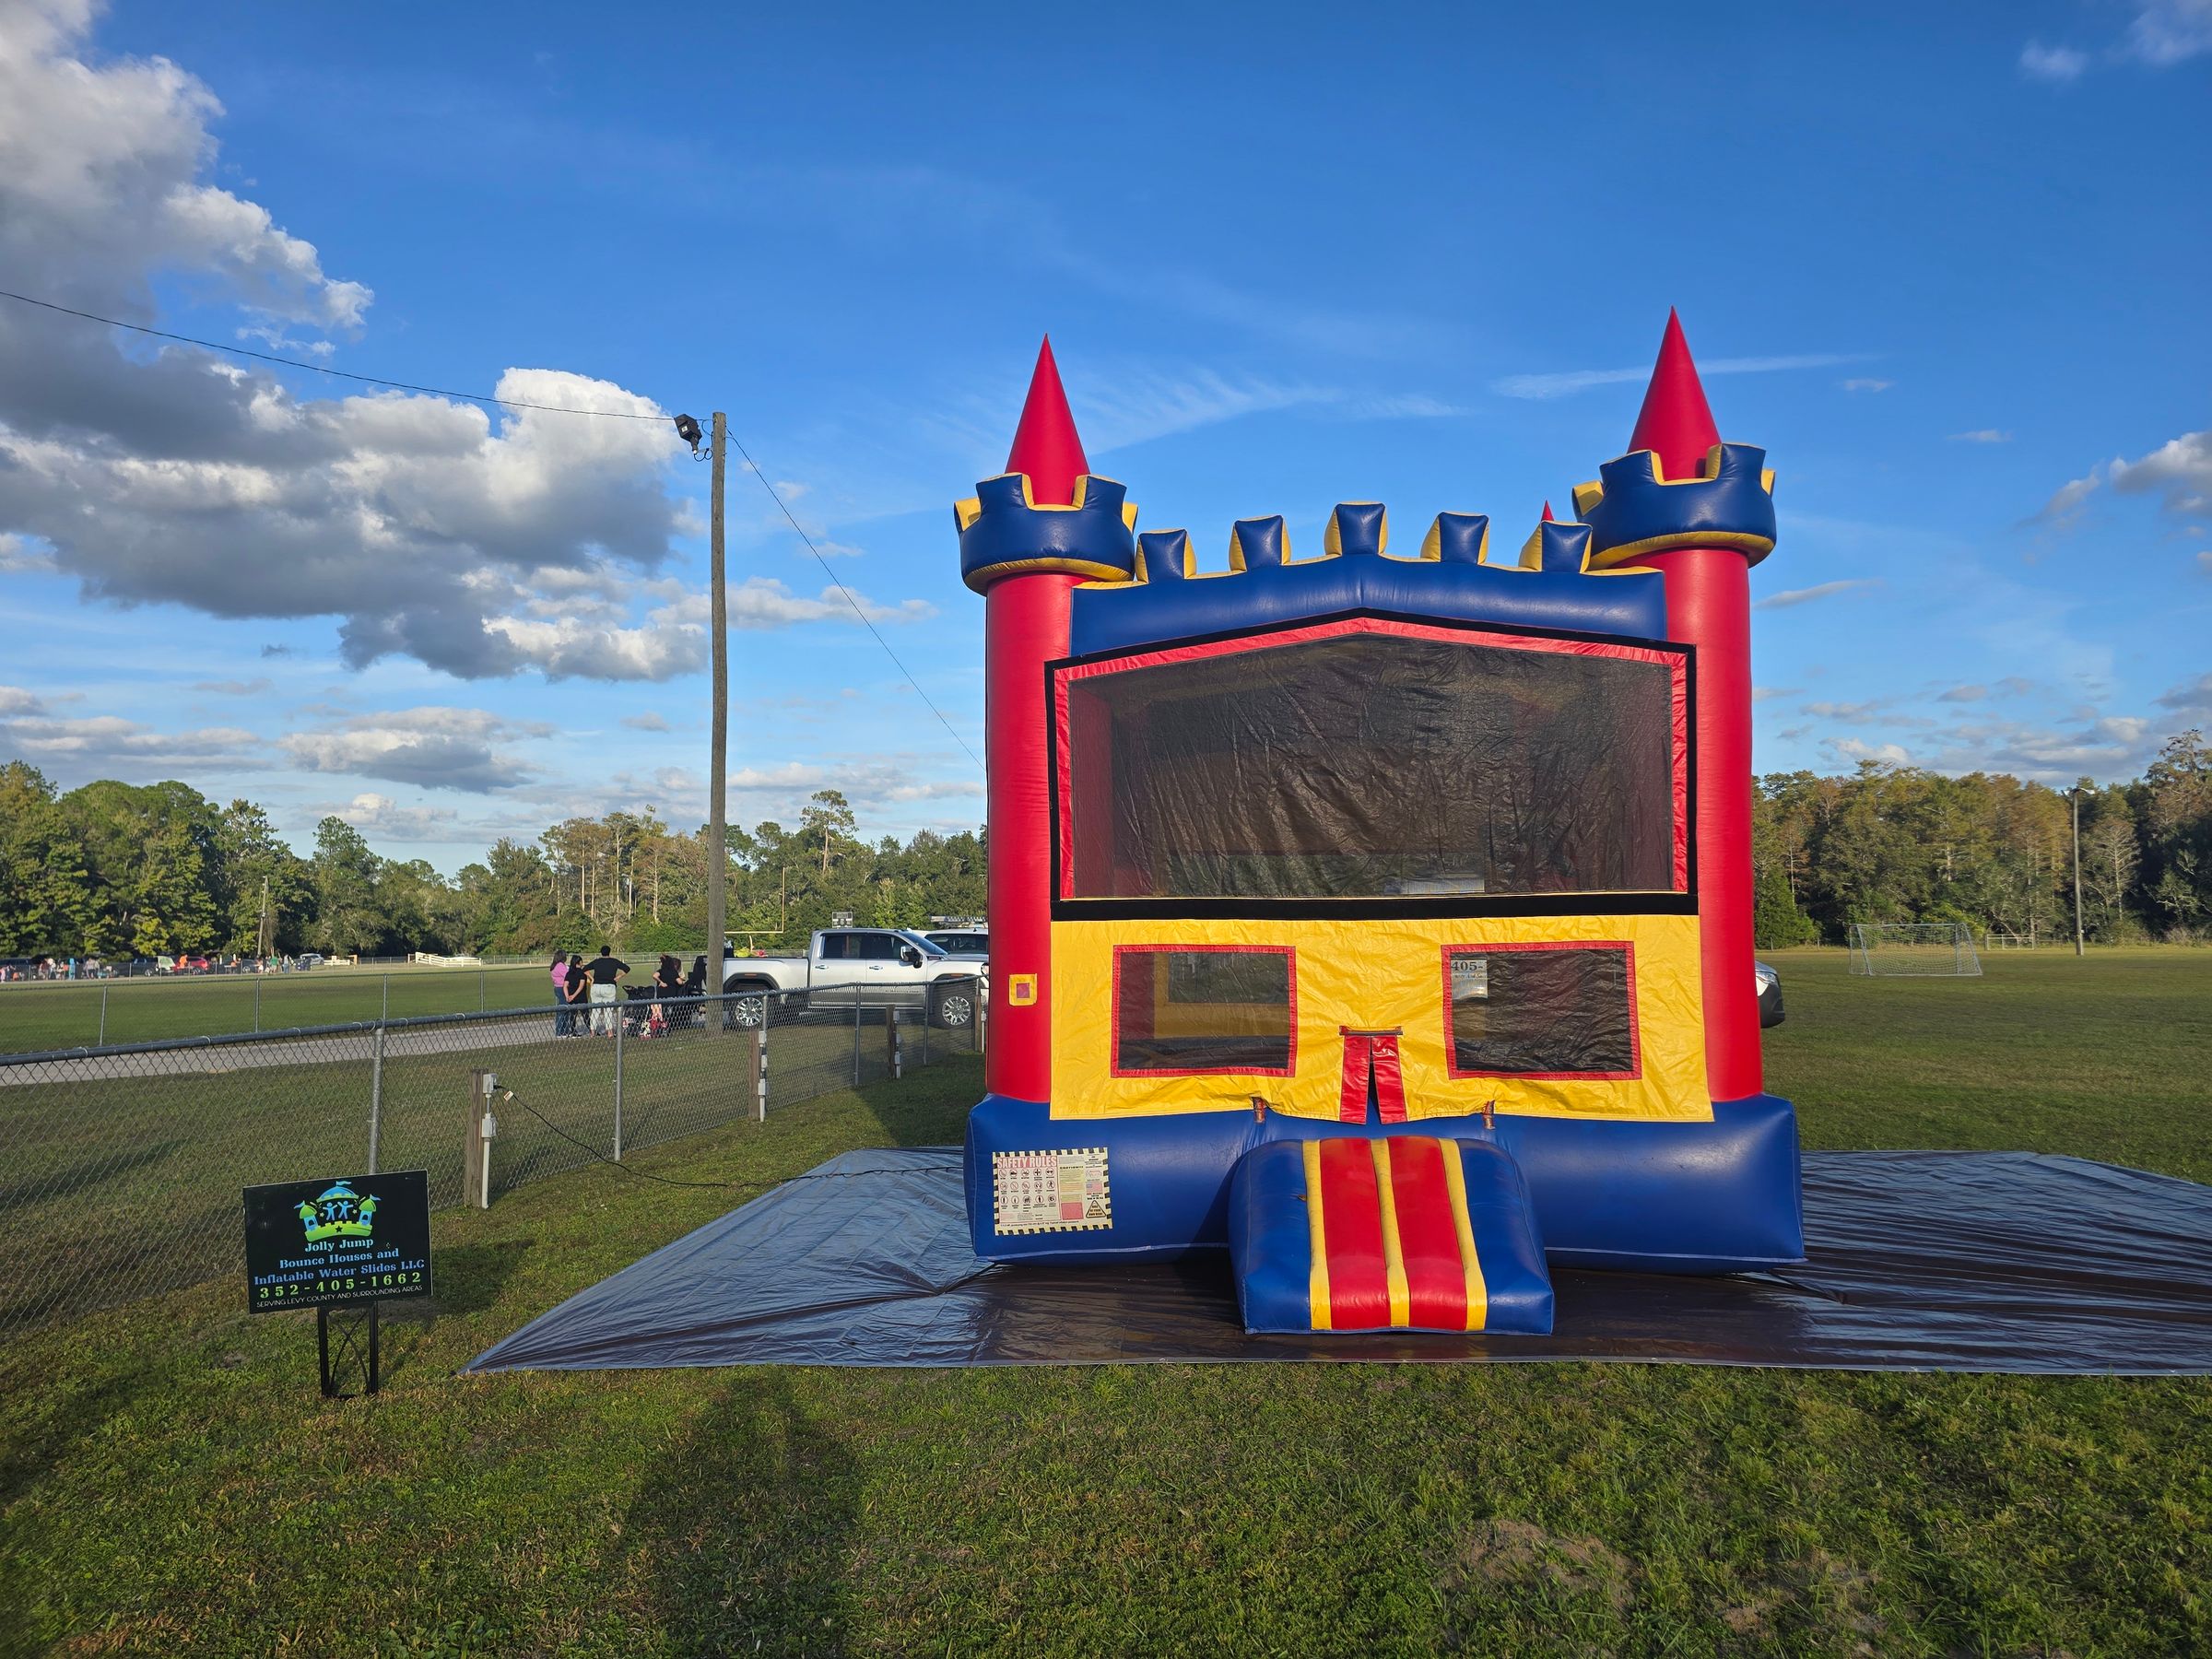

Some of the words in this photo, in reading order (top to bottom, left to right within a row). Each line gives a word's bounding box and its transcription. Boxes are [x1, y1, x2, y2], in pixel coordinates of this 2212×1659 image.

[997, 1156, 1030, 1169] SAFETY
[1030, 1155, 1057, 1168] RULES
[304, 1241, 335, 1253] Jolly
[339, 1238, 374, 1249] Jump
[279, 1257, 325, 1269] Bounce
[329, 1252, 373, 1264] Houses
[376, 1247, 399, 1259] and
[253, 1271, 314, 1285] Inflatable
[319, 1267, 357, 1278] Water
[360, 1263, 396, 1274] Slides
[401, 1259, 425, 1270] LLC
[256, 1299, 287, 1308] SERVING
[287, 1297, 305, 1305] LEVY
[306, 1293, 336, 1302] COUNTY
[352, 1287, 401, 1298] SURROUNDING
[401, 1284, 423, 1292] AREAS
